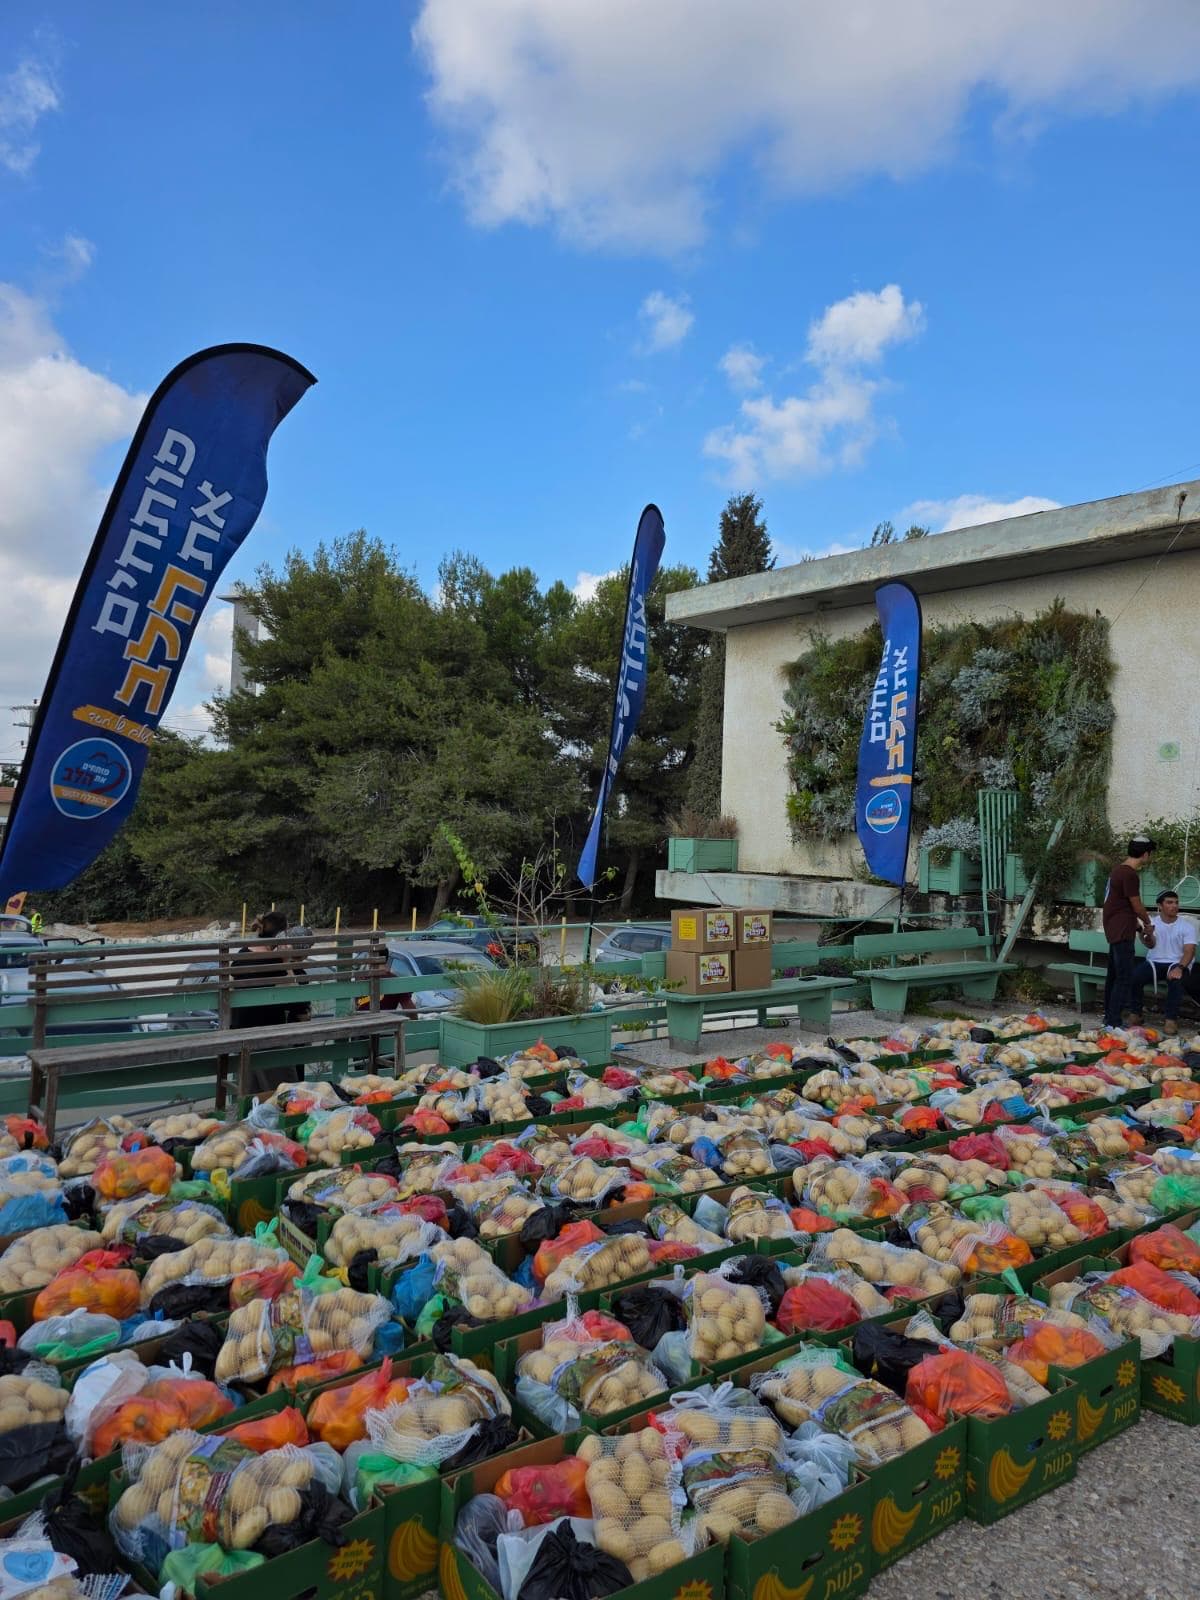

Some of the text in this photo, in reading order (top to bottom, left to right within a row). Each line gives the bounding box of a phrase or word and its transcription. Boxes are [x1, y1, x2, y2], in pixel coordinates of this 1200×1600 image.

[92, 428, 196, 638] פותחים
[114, 480, 233, 716] את הלב
[893, 646, 908, 690] את
[869, 640, 890, 743] פותחים
[886, 690, 907, 769] הלב
[82, 762, 110, 776] פותחים
[94, 774, 107, 784] את
[929, 1491, 961, 1524] בננות
[823, 1562, 863, 1600] בננות
